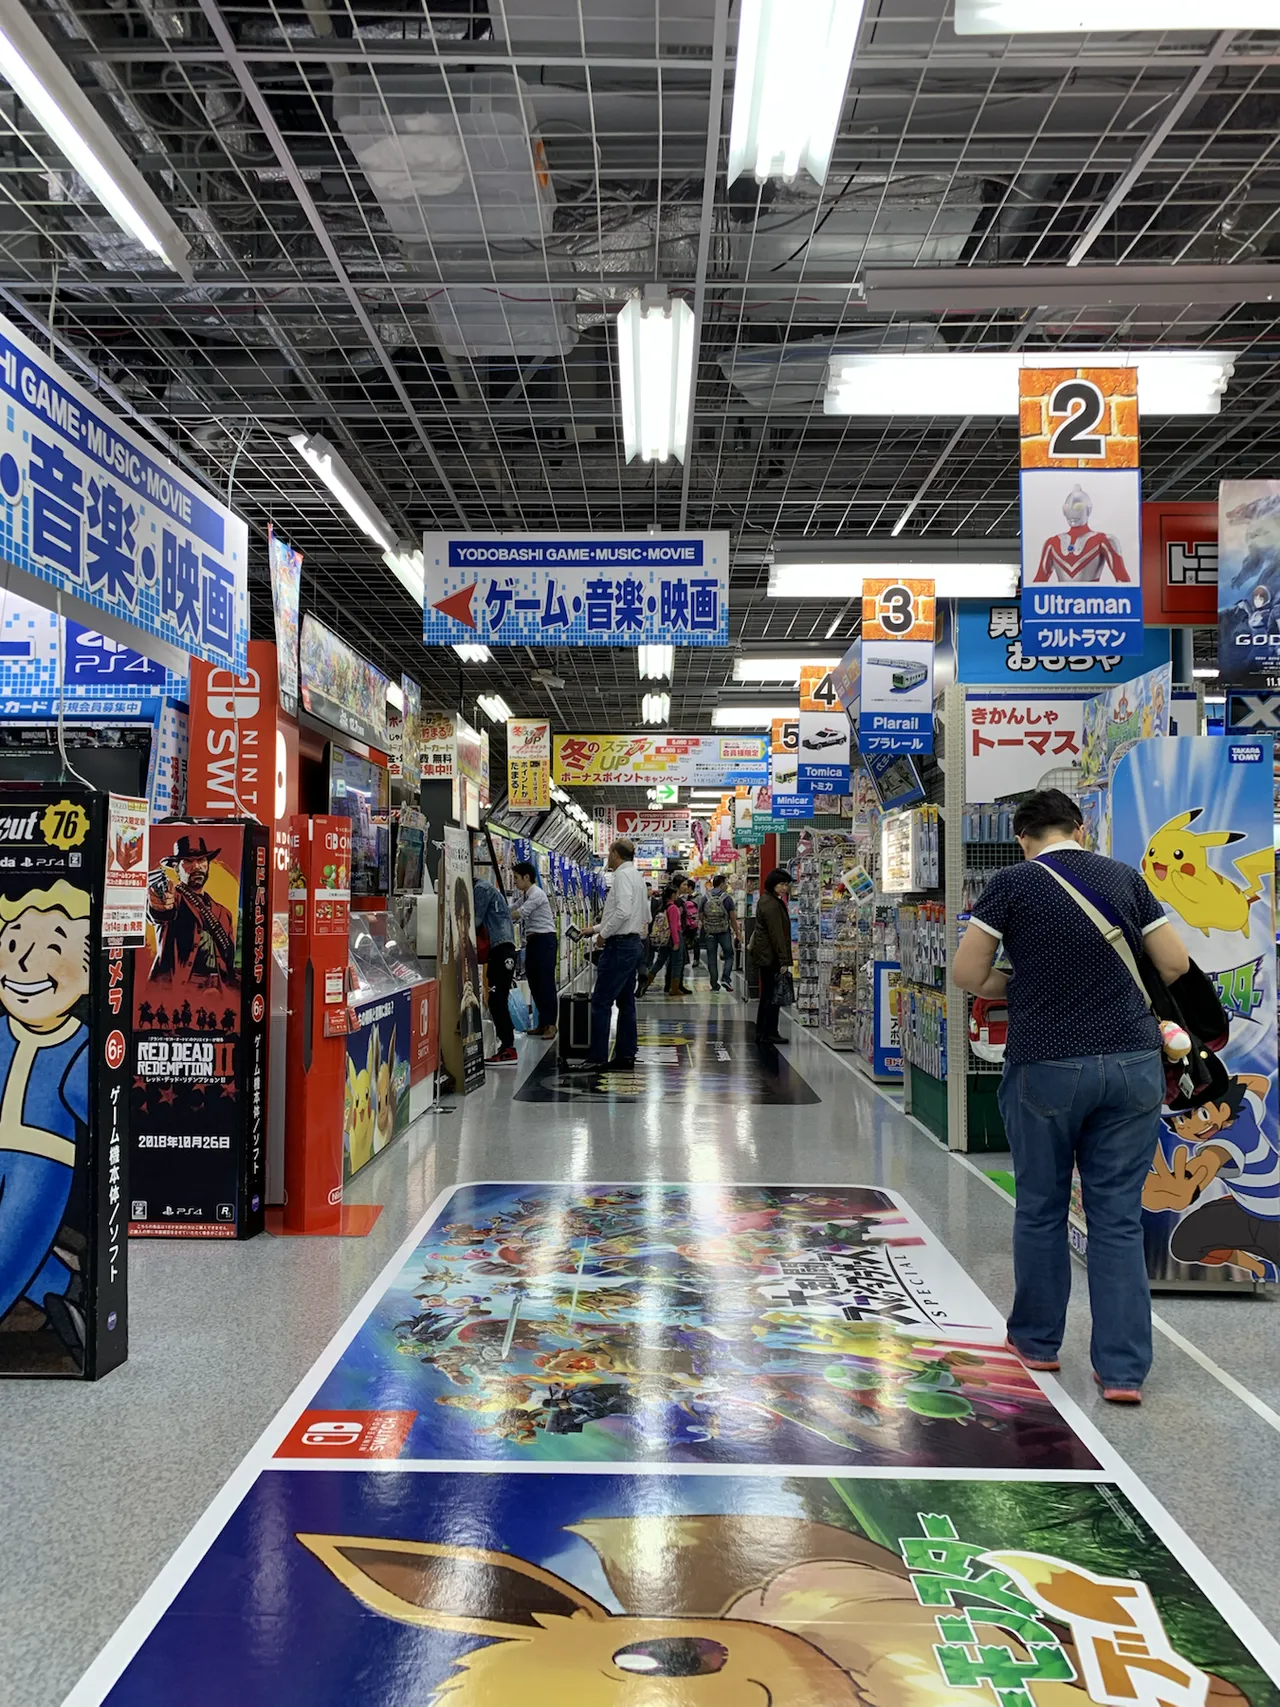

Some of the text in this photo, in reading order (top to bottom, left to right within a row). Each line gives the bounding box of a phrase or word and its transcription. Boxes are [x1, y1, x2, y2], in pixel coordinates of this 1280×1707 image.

[1052, 380, 1105, 458] 2
[457, 548, 543, 561] YODOBASHI
[485, 577, 719, 632] ゲーム・音楽・映画
[880, 586, 914, 634] 3
[1033, 595, 1132, 615] Ultraman
[989, 607, 1022, 638] 男
[1038, 626, 1126, 648] ウルトラマン
[75, 655, 152, 673] PS4
[812, 671, 836, 706] 4
[0, 700, 48, 714] カード
[971, 707, 1059, 725] きかんしゃ
[873, 716, 919, 731] Plarail
[782, 723, 799, 749] 5
[868, 737, 924, 751] プラレール
[972, 729, 1080, 757] トーマス
[560, 737, 600, 771] 冬の
[1231, 747, 1261, 755] TAKARA
[1231, 754, 1261, 762] TOMY
[600, 755, 630, 771] UP
[805, 767, 843, 777] Tomica
[242, 730, 258, 818] NINT
[810, 782, 834, 791] トミカ
[777, 796, 808, 805] Minicar
[780, 808, 805, 816] ミニカー
[52, 811, 79, 840] 76
[36, 859, 65, 867] PS4
[253, 1001, 264, 1015] 6F
[107, 1038, 123, 1061] 6F
[138, 1042, 169, 1061] RED
[171, 1042, 213, 1062] DEAD
[137, 1061, 213, 1076] REDEMPTION
[138, 1135, 230, 1149] 2018年10月26日
[176, 1207, 203, 1216] PS4
[894, 1253, 949, 1319] SPECIAL
[369, 1416, 398, 1452] SWITCH
